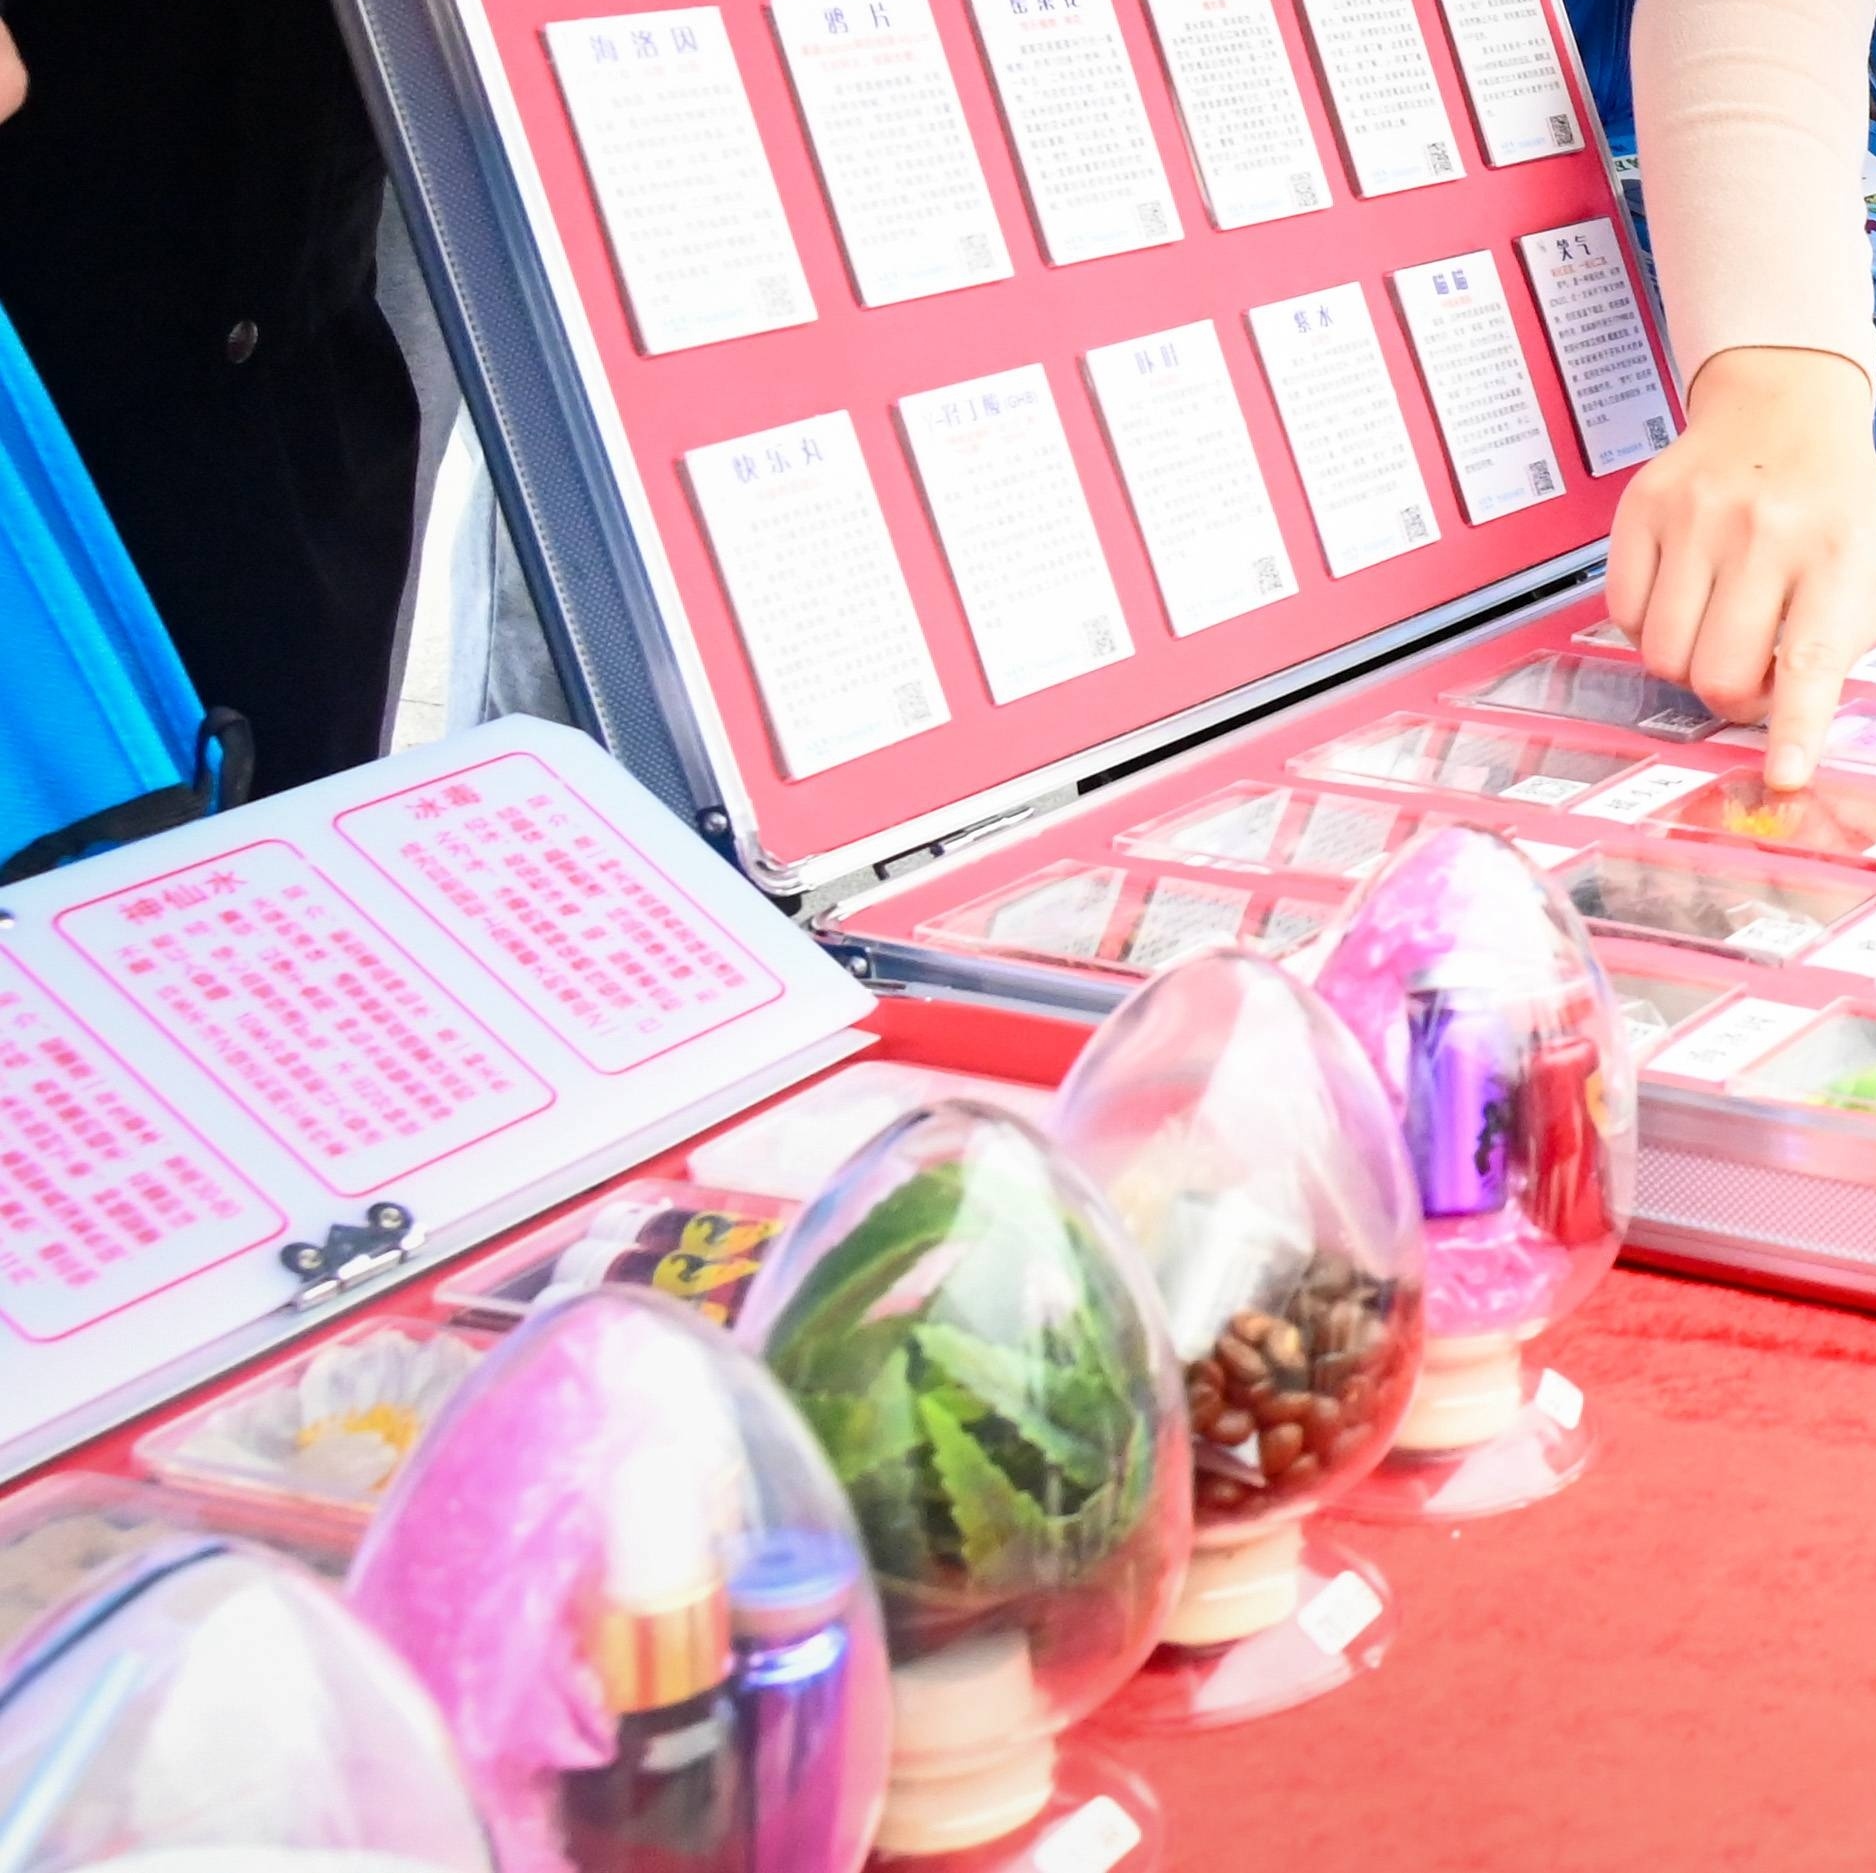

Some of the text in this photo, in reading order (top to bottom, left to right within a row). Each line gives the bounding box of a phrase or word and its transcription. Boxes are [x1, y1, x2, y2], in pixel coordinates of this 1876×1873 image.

[823, 1, 892, 34] 鸦片
[588, 24, 702, 66] 海洛因
[1555, 234, 1592, 262] 笑气
[732, 435, 825, 484] 快乐丸
[117, 869, 250, 925] 神仙水
